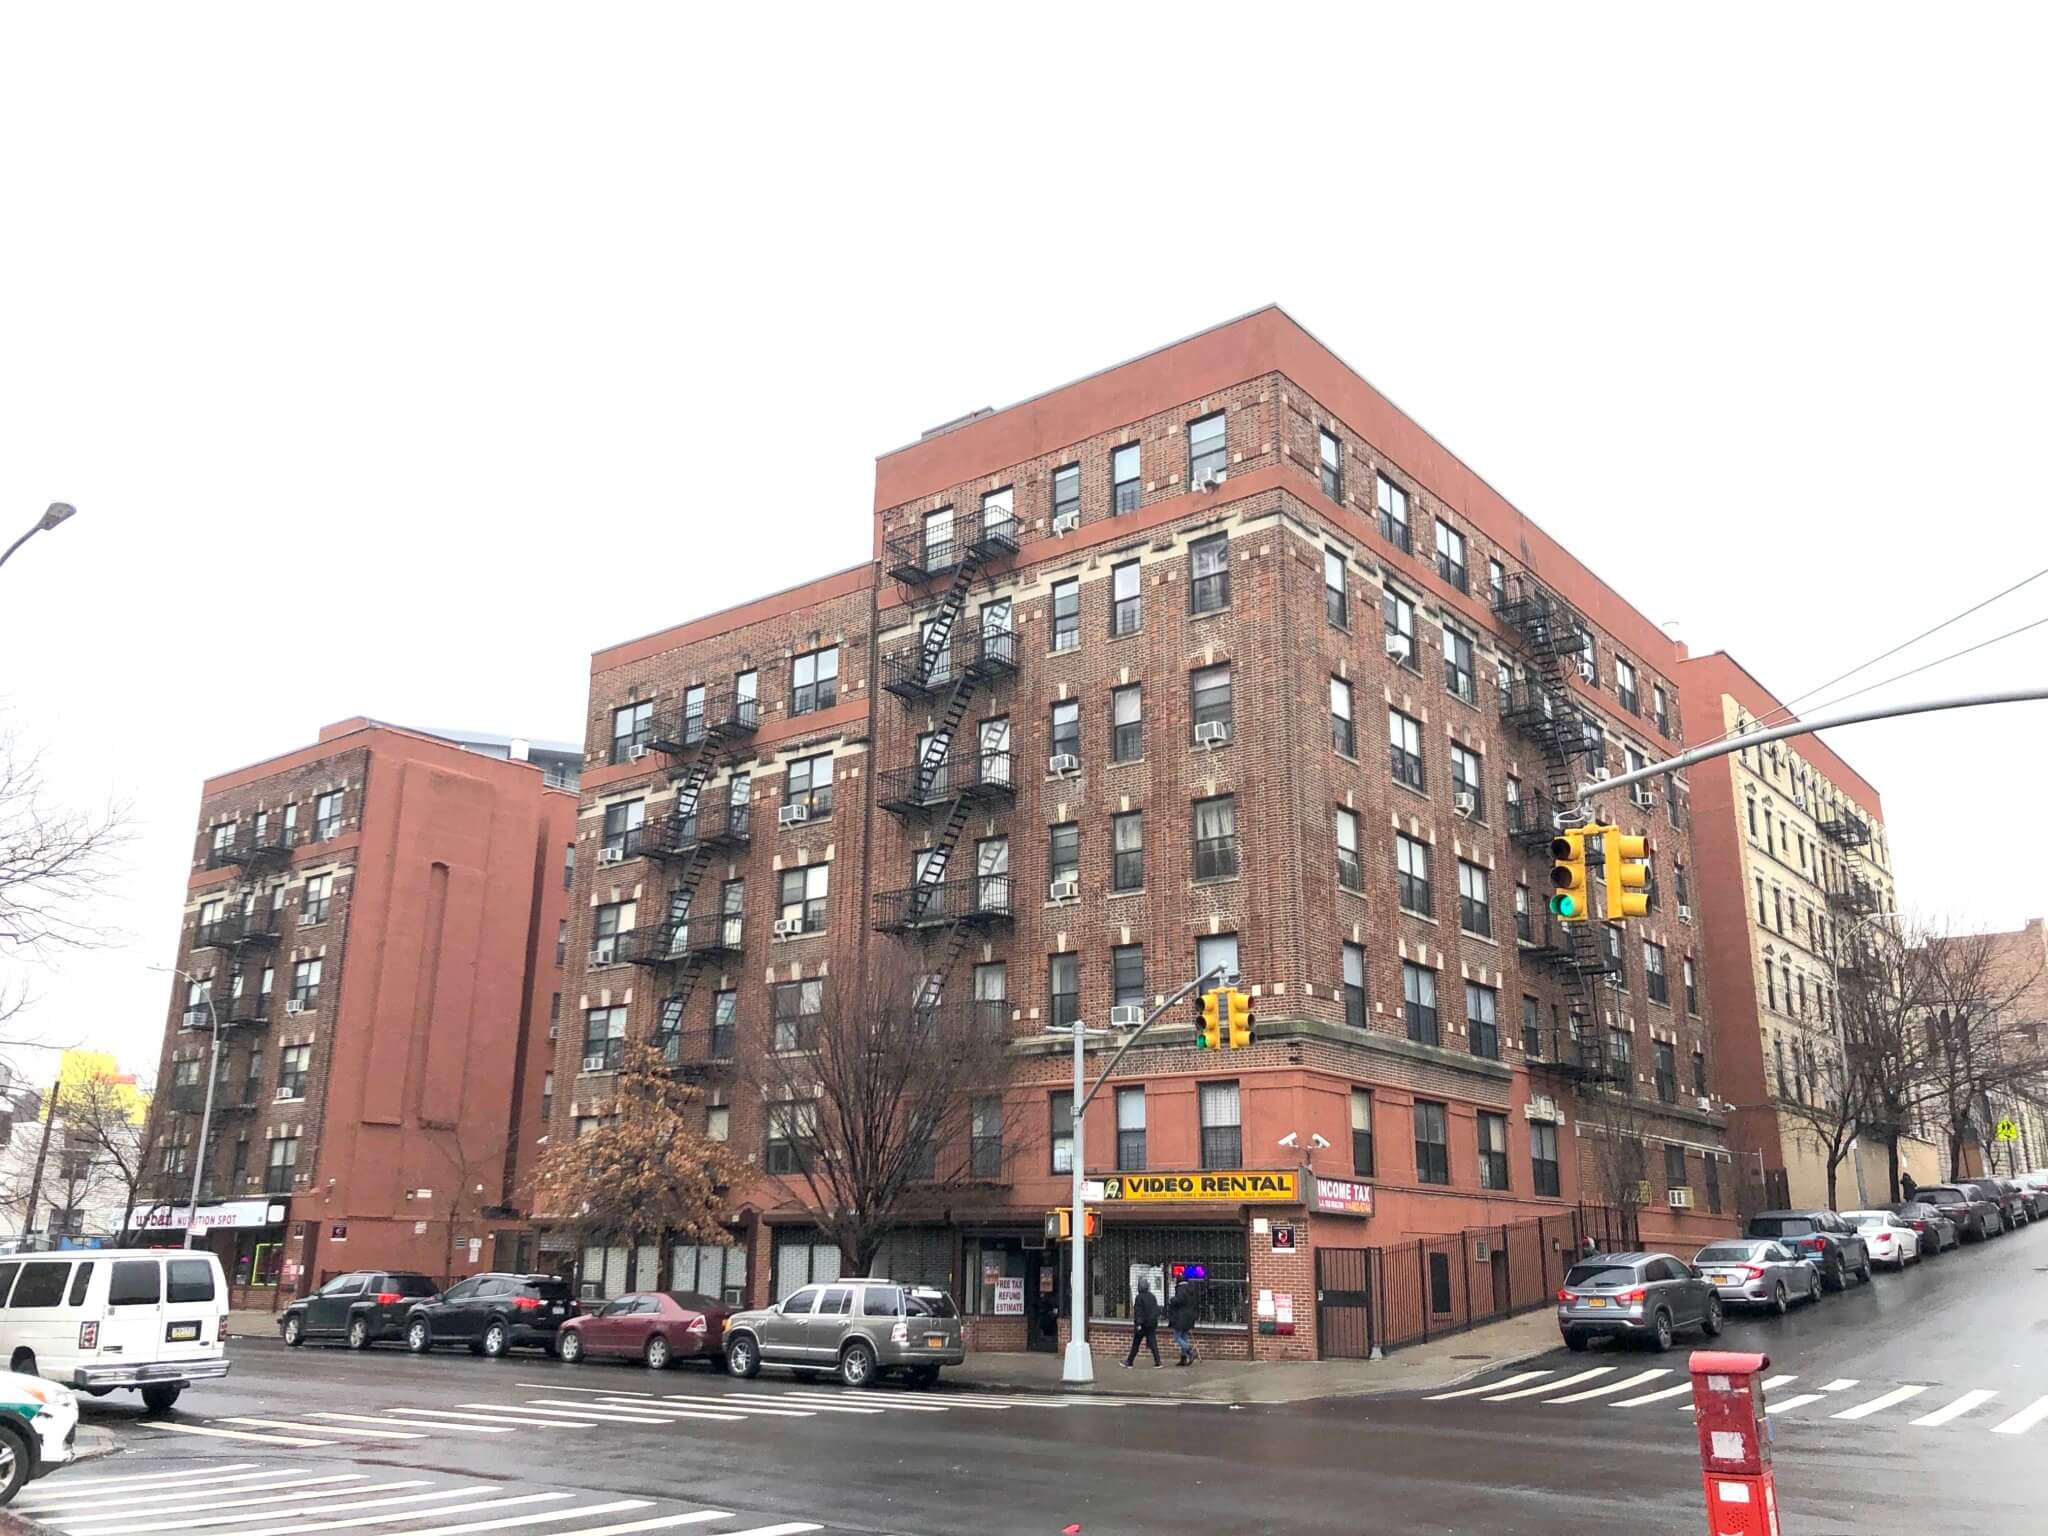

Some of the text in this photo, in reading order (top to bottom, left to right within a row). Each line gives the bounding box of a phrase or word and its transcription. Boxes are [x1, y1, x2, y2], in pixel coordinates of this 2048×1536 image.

[1128, 1176, 1292, 1192] VIDEO RENTAL
[1317, 1180, 1370, 1202] INCOME TAX
[217, 1214, 238, 1226] SPOT
[1012, 1279, 1023, 1289] TAX
[999, 1291, 1021, 1300] REFUND
[996, 1303, 1023, 1313] ESTIMATE
